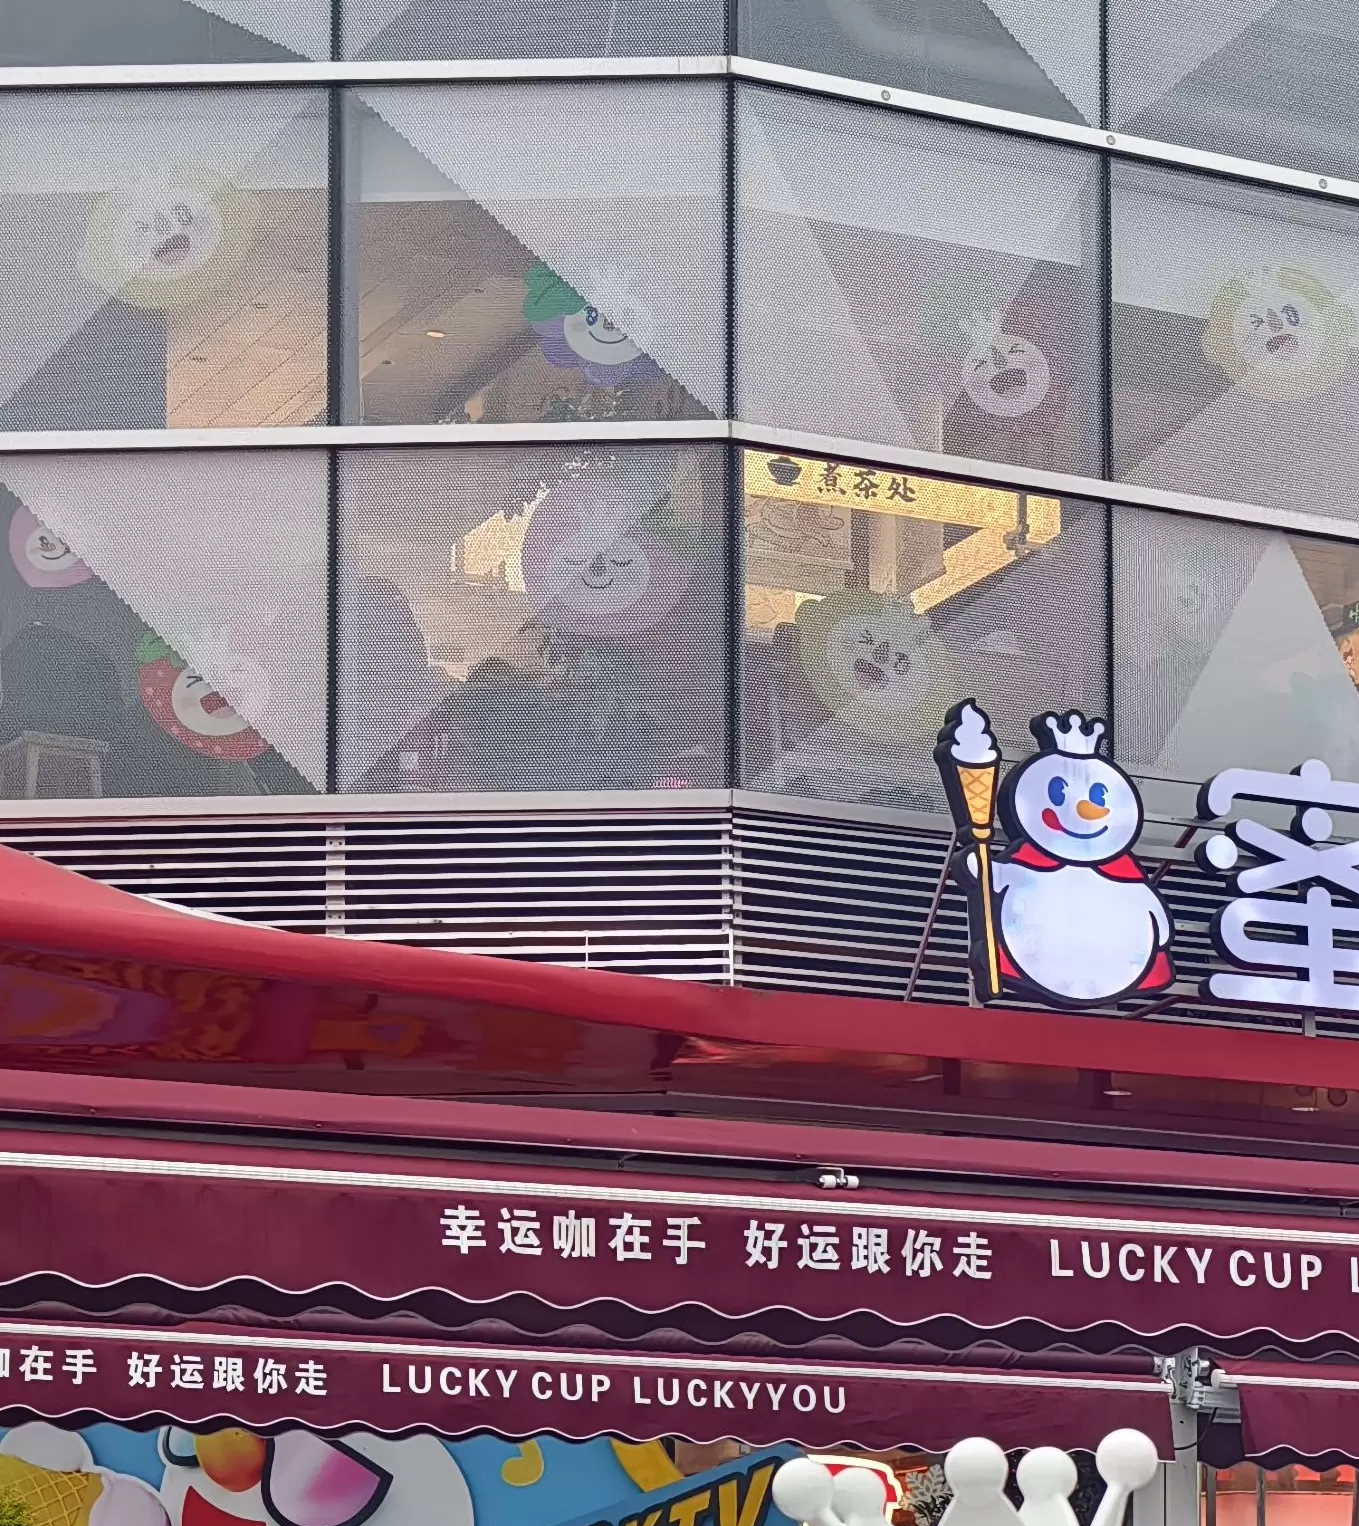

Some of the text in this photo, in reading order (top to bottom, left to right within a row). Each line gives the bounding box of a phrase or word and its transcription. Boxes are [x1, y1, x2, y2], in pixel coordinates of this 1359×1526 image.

[816, 462, 918, 503] 煮茶处
[440, 1204, 994, 1281] 幸运咖在手 好运跟你走
[1050, 1239, 1212, 1284] LUCKY
[1229, 1250, 1324, 1291] CUP
[127, 1351, 328, 1396] 好运跟你走
[381, 1363, 848, 1414] LUCKY CUP LUCKYYOU
